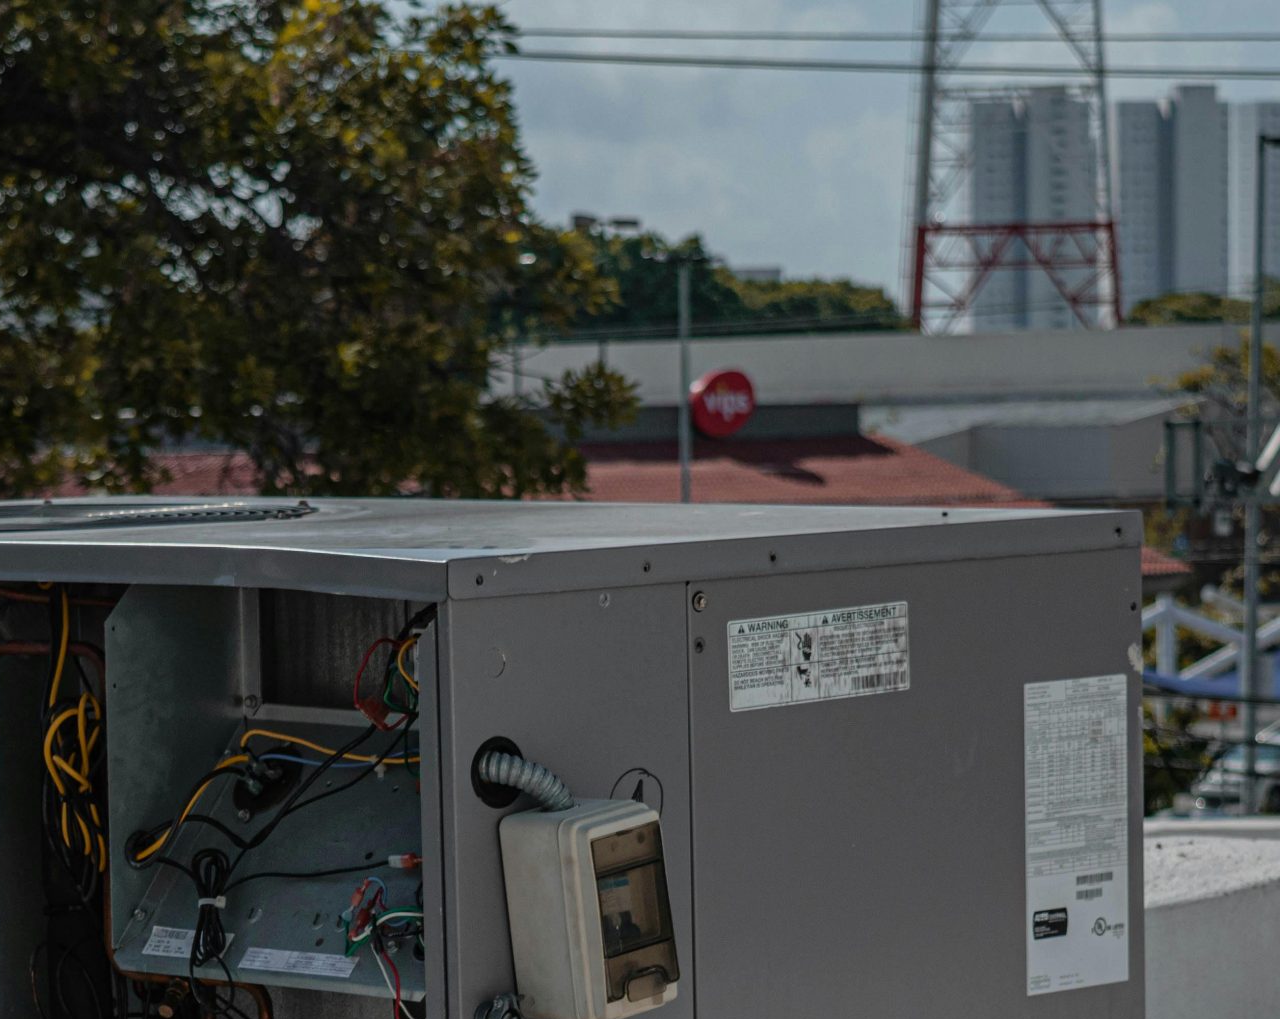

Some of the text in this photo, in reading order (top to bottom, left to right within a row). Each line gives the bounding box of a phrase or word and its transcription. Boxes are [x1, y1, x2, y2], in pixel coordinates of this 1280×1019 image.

[703, 385, 749, 422] vips
[831, 606, 897, 623] AVERTISSEMENT
[747, 620, 789, 633] WARNING
